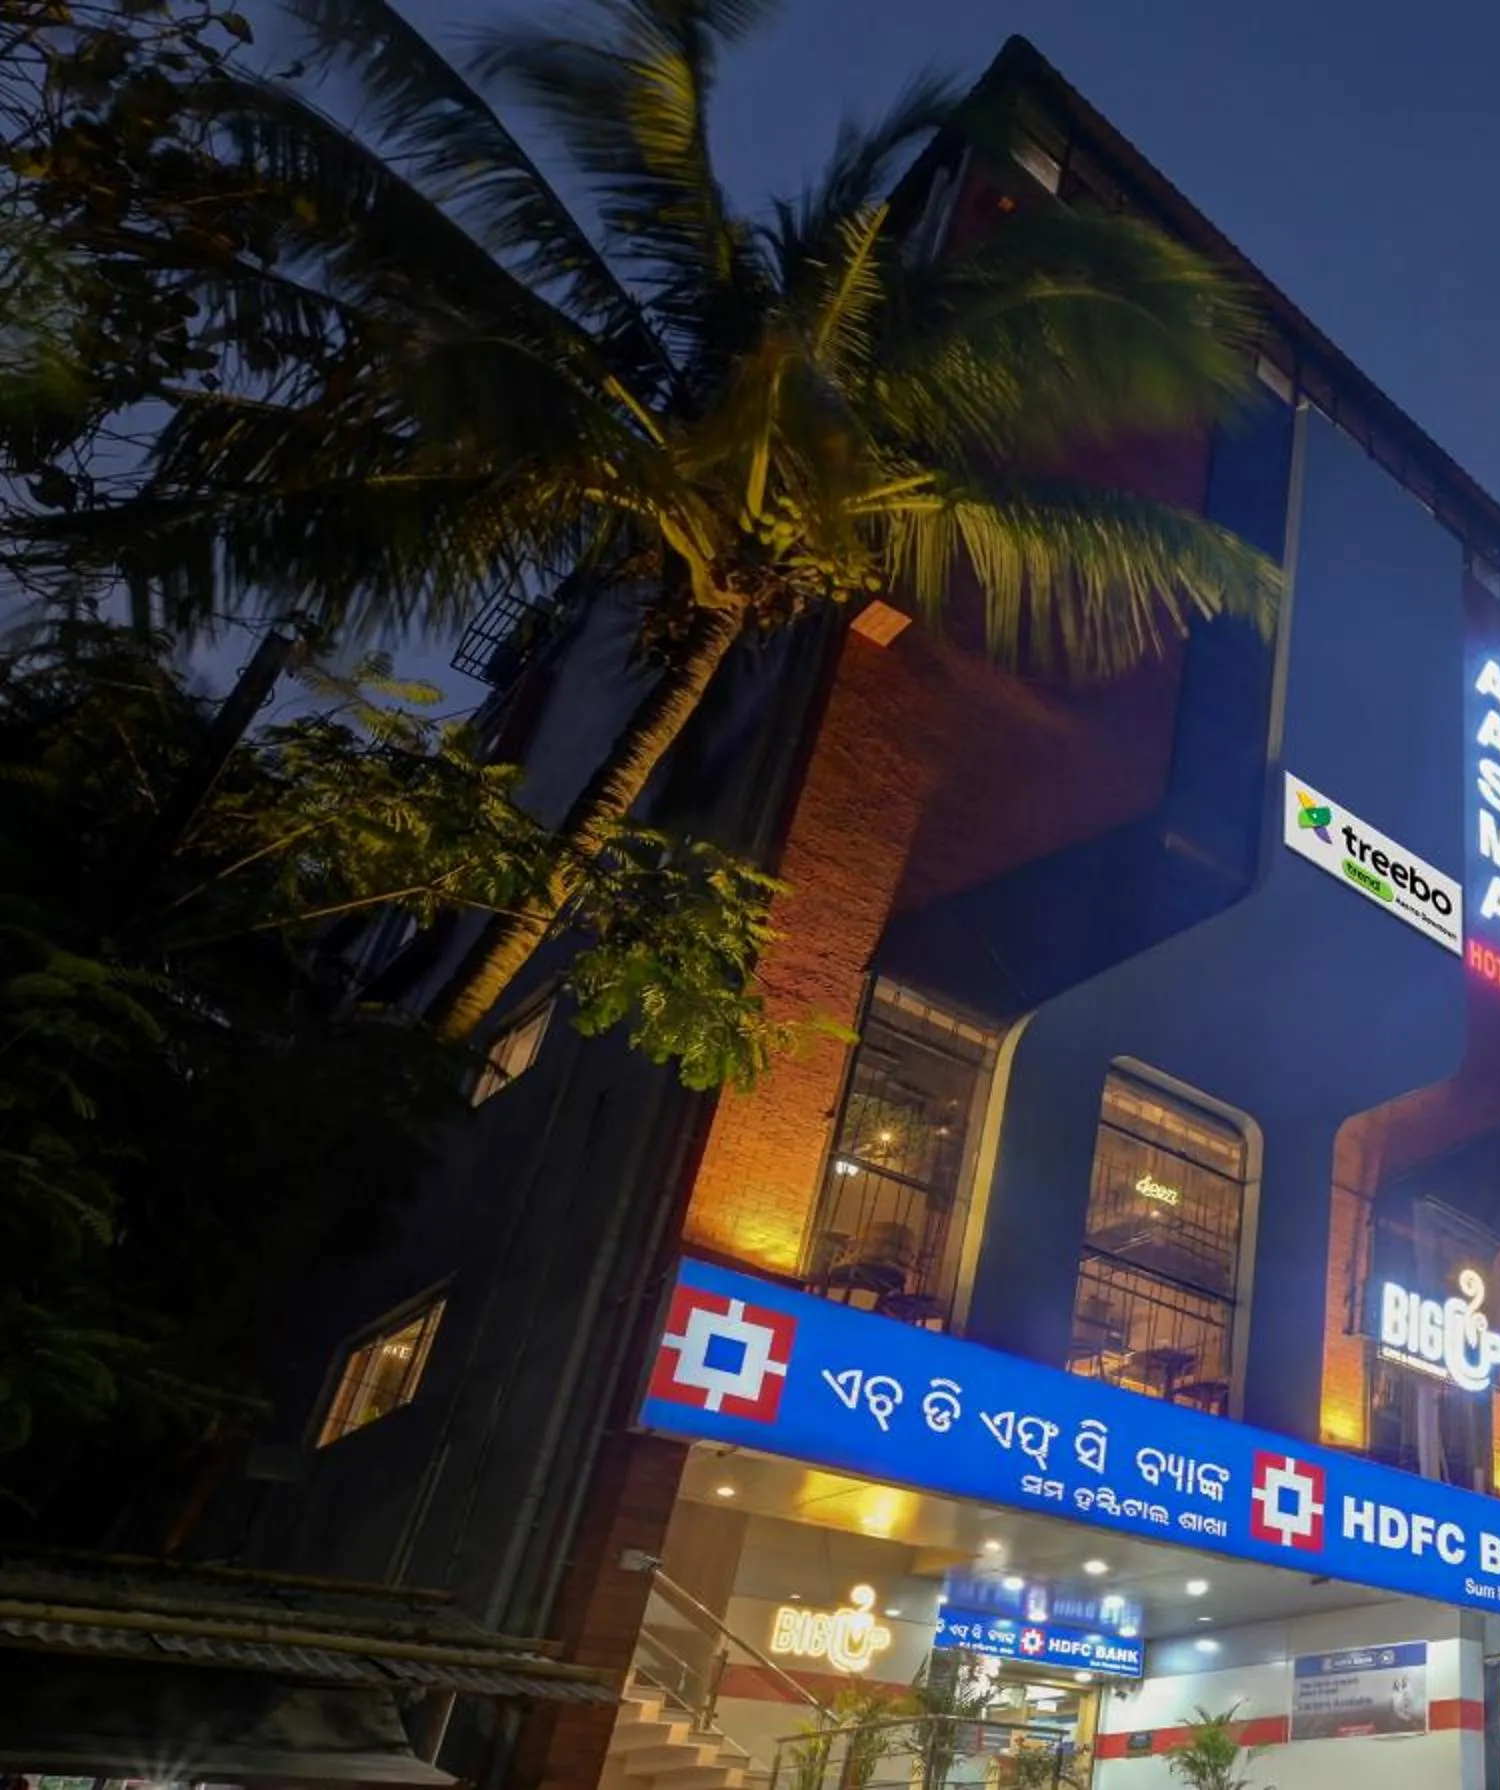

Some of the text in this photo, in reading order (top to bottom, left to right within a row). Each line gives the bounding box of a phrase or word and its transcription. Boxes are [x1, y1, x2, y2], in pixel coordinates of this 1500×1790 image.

[1342, 825, 1452, 915] treebo
[922, 1378, 962, 1433] ଡି
[1074, 1419, 1108, 1474] ସି
[1342, 1495, 1467, 1566] HDFC
[1465, 1577, 1496, 1600] Sum
[1048, 1638, 1139, 1663] HDFC BANK
